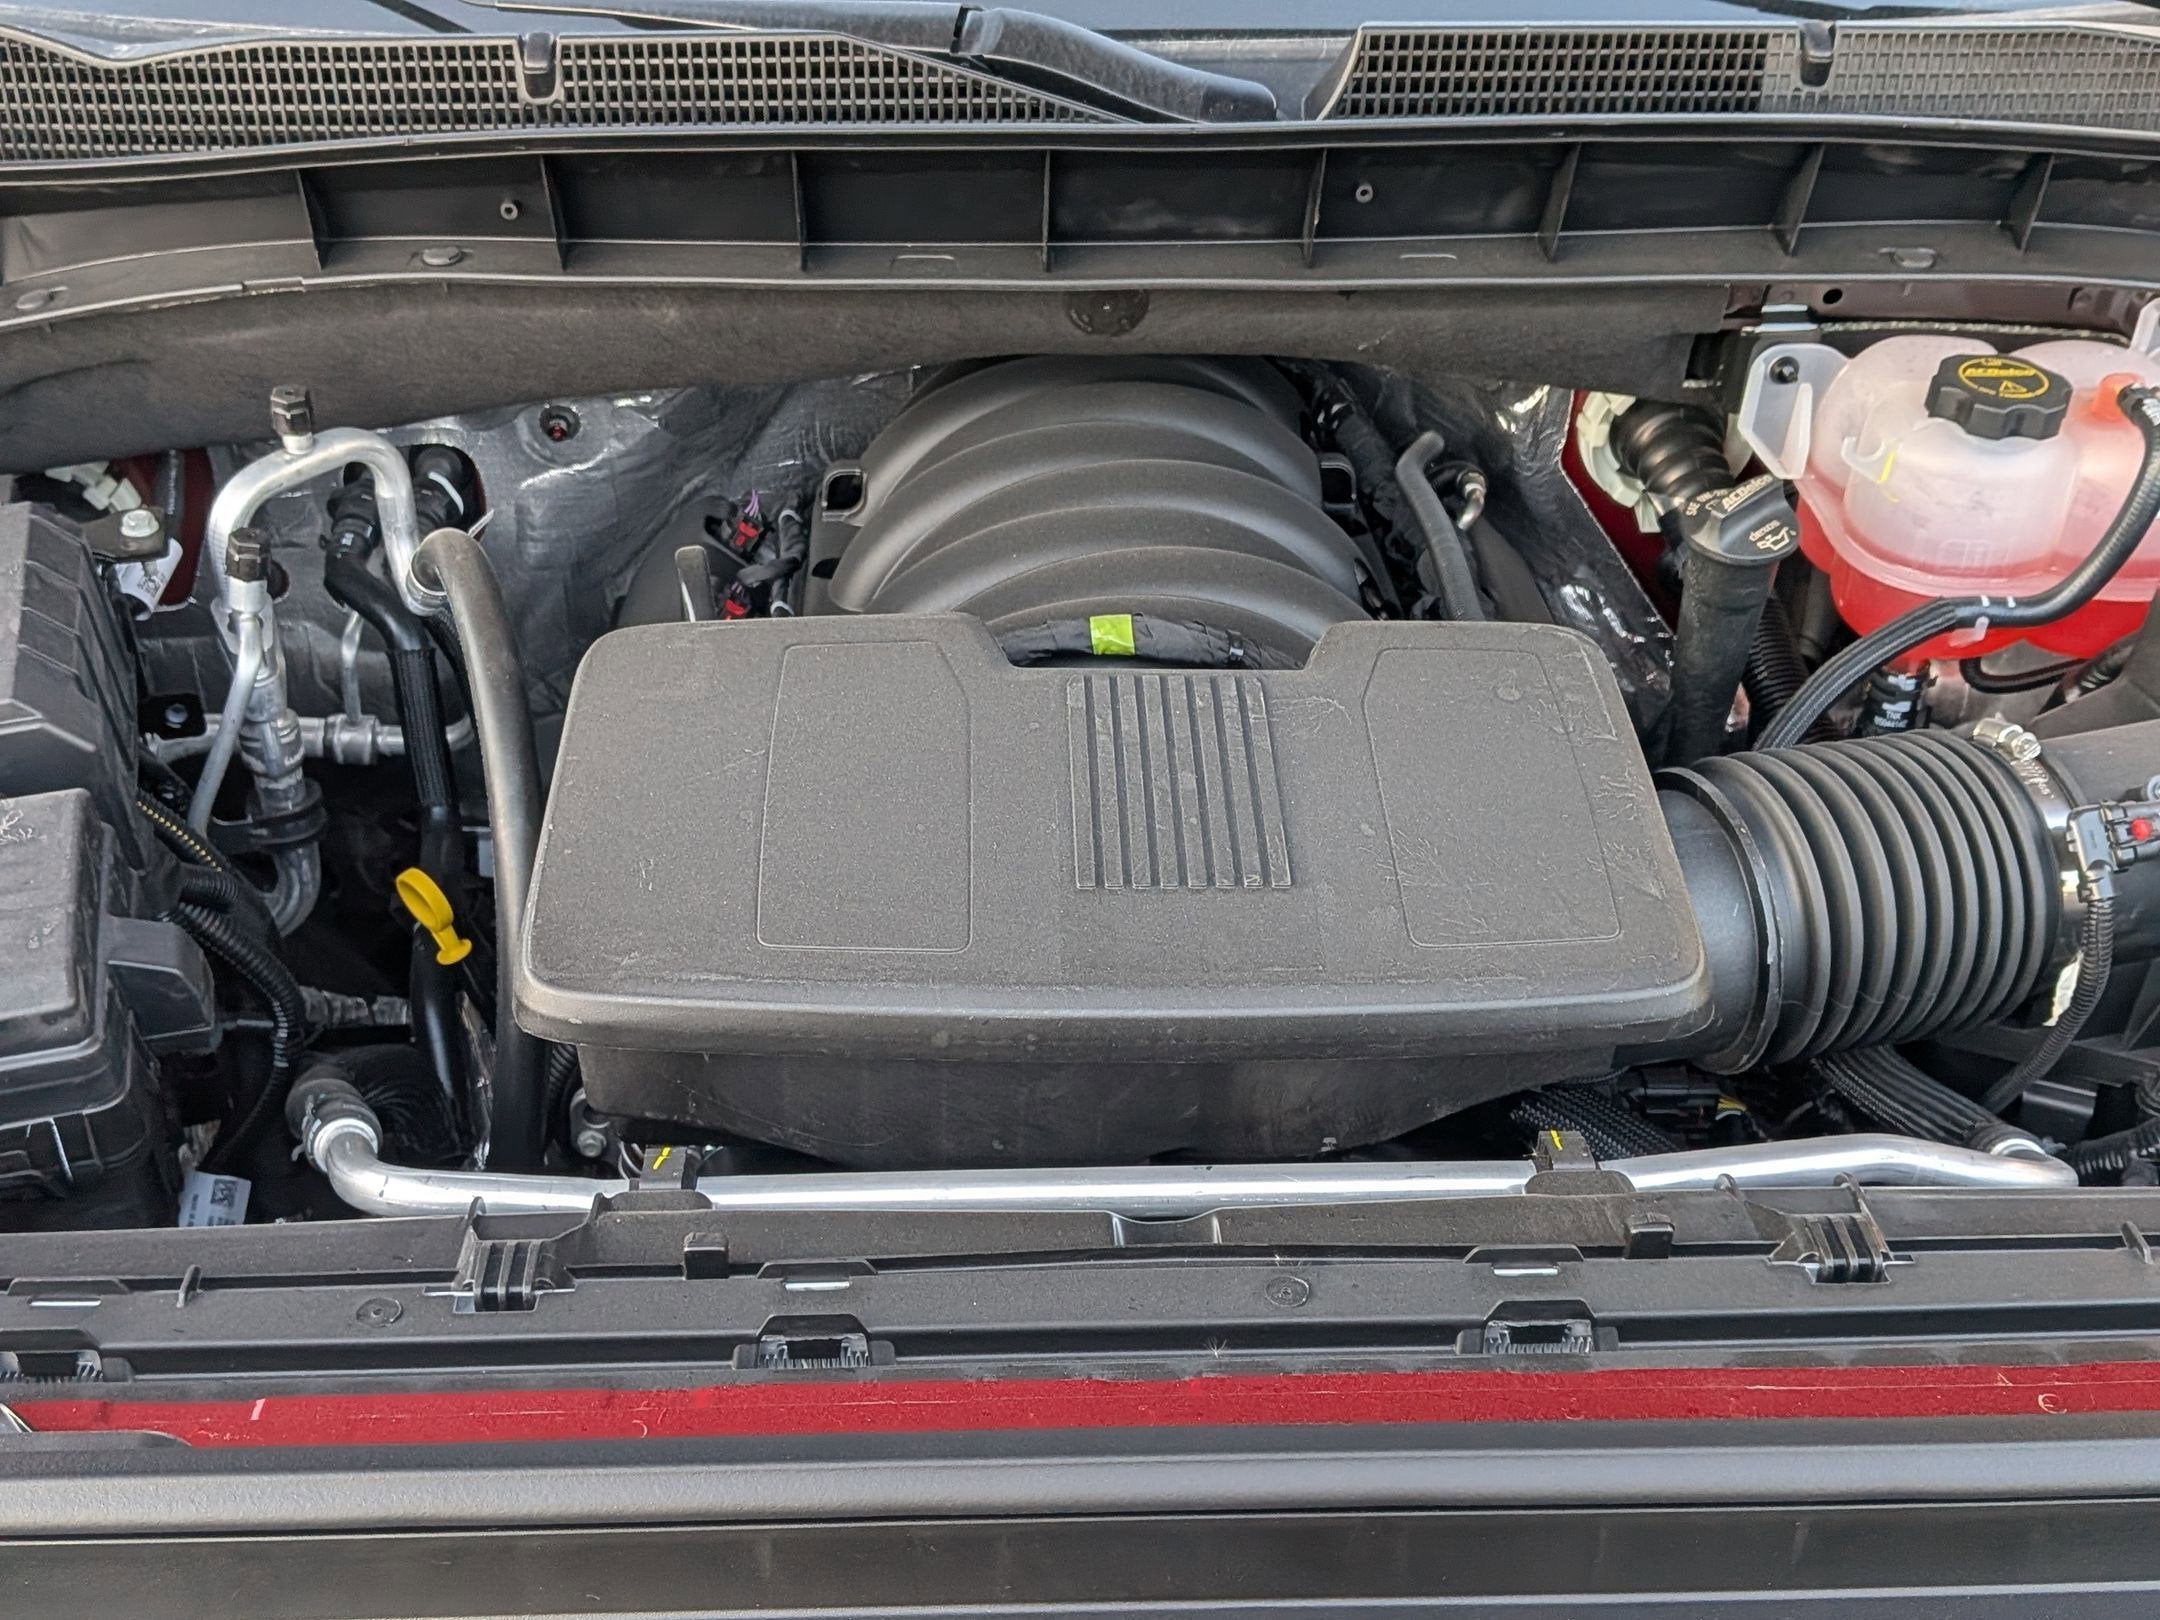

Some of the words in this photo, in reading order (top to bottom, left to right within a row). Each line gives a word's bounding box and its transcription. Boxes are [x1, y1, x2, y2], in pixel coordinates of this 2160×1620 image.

[1963, 367, 2037, 378] ACDelco
[1721, 474, 1773, 510] ACDelco
[1685, 501, 1701, 516] SAE
